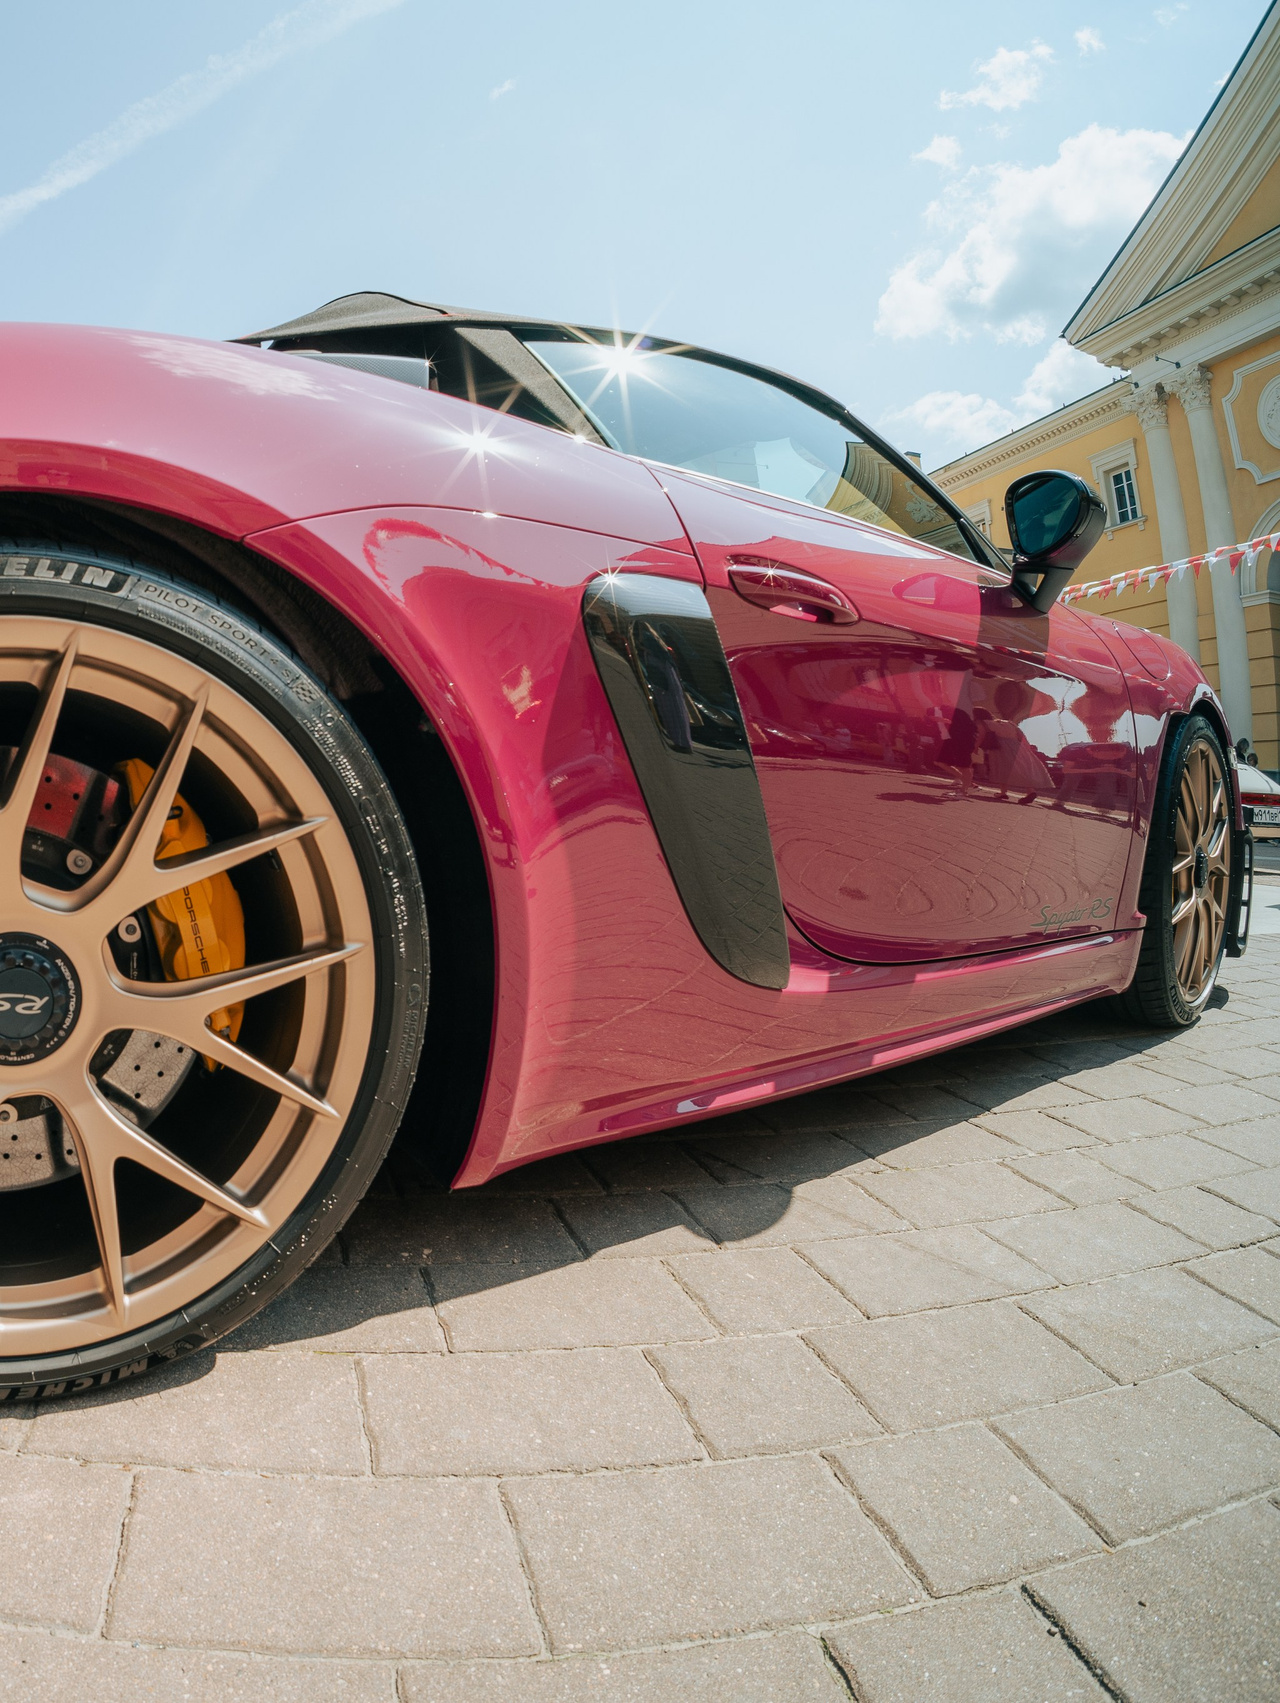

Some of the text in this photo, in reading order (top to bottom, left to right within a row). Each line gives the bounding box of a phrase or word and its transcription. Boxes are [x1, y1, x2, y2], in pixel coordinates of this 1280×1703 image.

[144, 584, 203, 614] PILOT
[207, 614, 272, 656] SPORT
[183, 886, 210, 974] PORSCHE
[1030, 897, 1114, 936] Spyder RS
